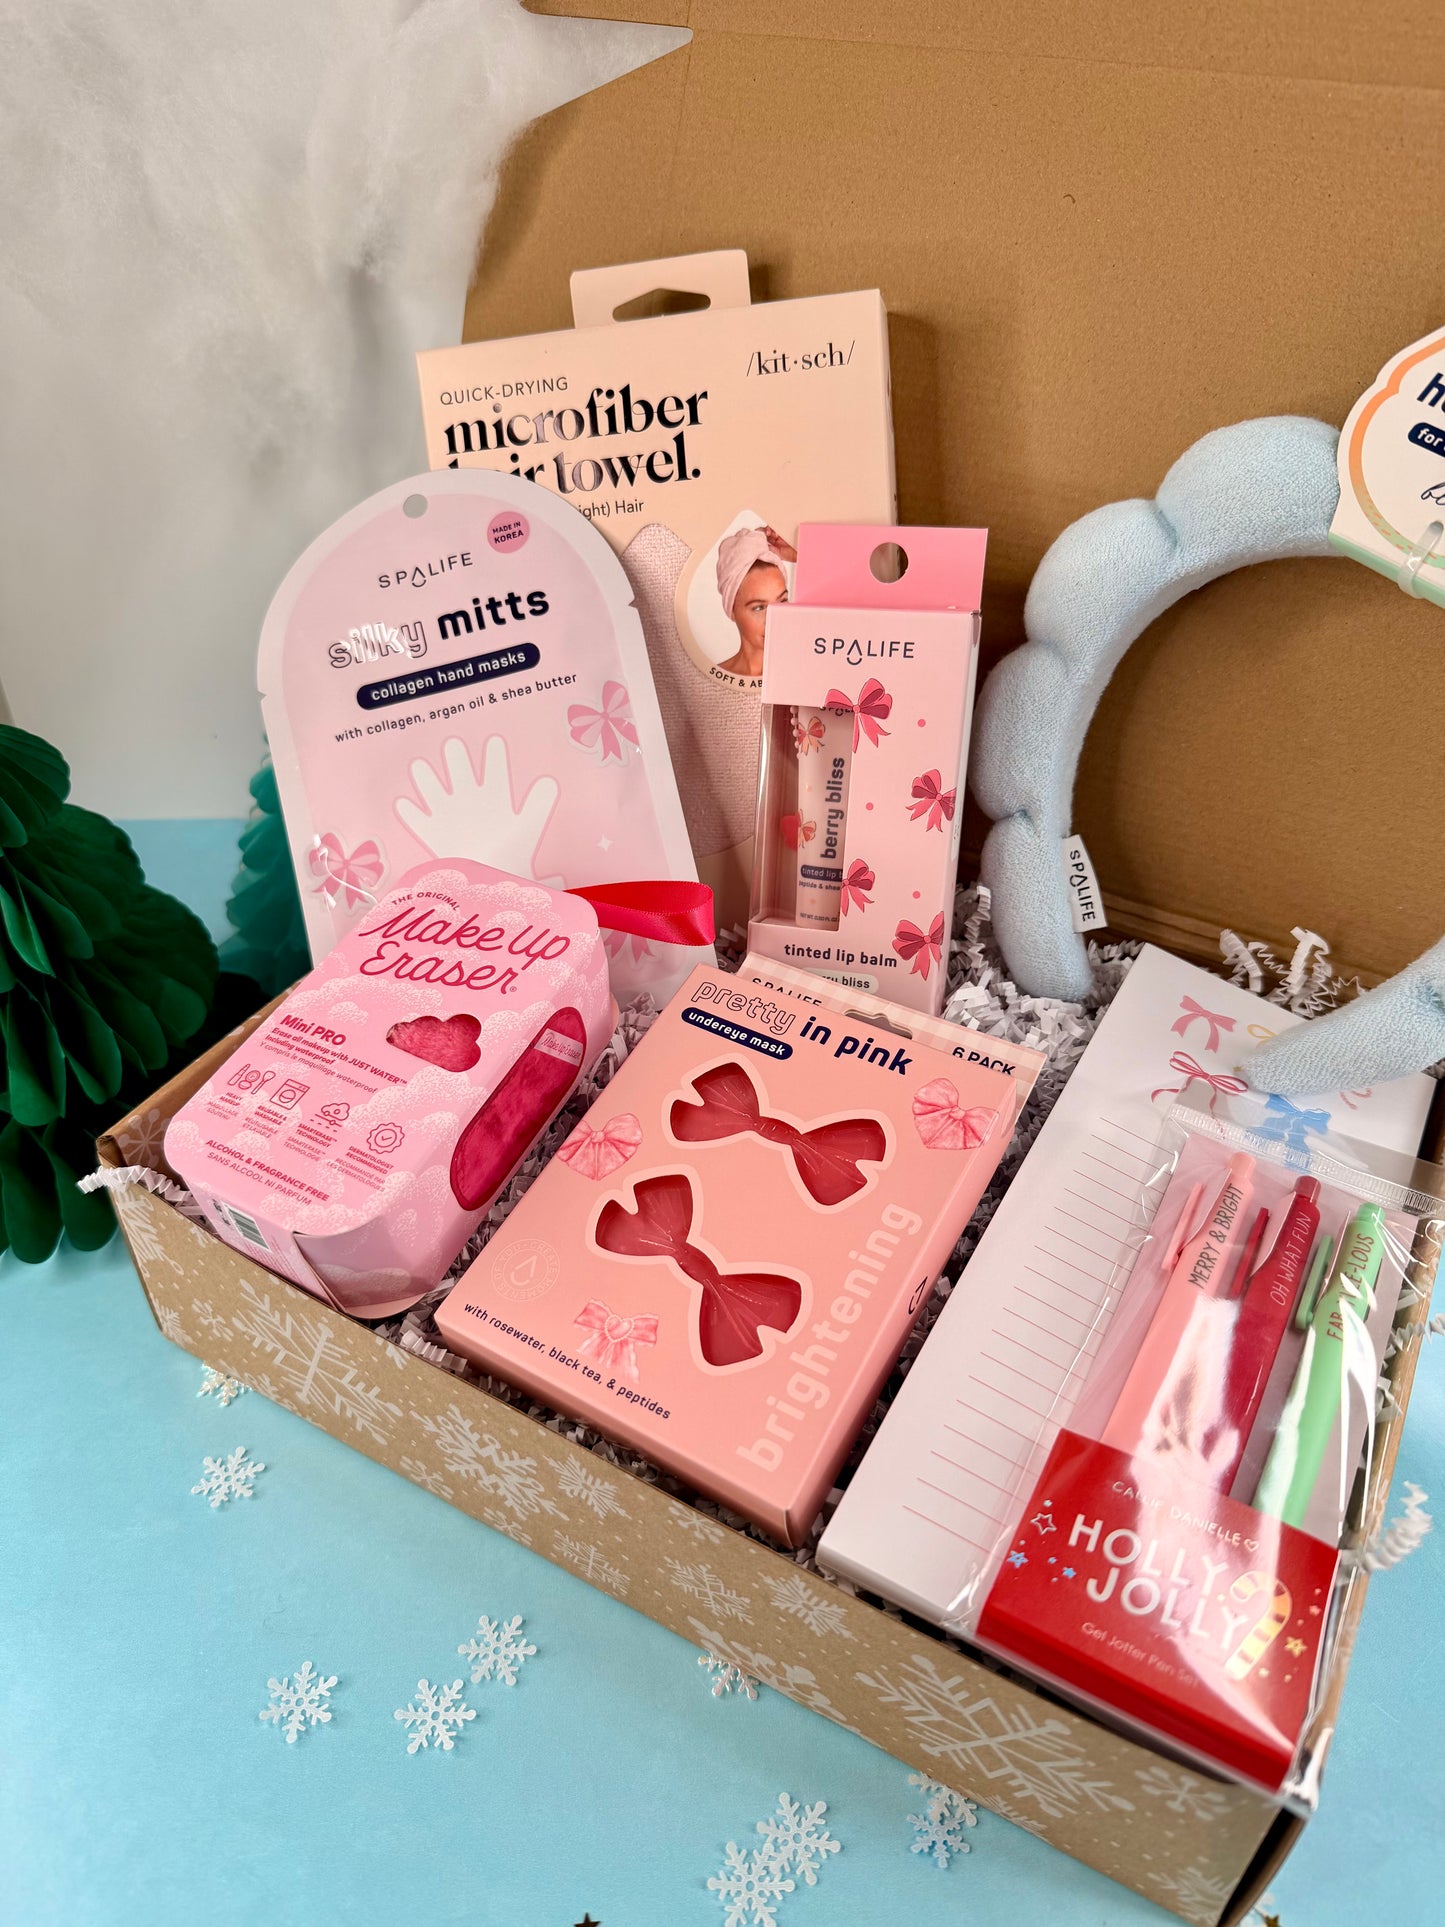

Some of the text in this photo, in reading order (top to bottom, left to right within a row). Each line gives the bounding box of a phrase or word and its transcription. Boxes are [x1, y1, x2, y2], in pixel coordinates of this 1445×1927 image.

[440, 376, 568, 405] QUICK-DRYING
[444, 383, 709, 455] microfiber
[1417, 428, 1444, 447] for
[552, 431, 701, 494] towel.
[492, 521, 522, 535] MADE IN
[615, 499, 645, 514] Hair
[494, 529, 524, 544] KOREA
[378, 552, 474, 588] SPALIFE
[328, 590, 550, 669] silky mitts
[814, 638, 915, 665] SPALIFE
[371, 651, 526, 701] collagen hand masks
[709, 667, 735, 686] SOFT
[738, 679, 746, 687] &
[335, 673, 578, 742] with collagen, argan oil & shea butter
[820, 757, 845, 859] berry bliss
[802, 867, 824, 877] tinted
[826, 870, 836, 879] lip
[1069, 850, 1096, 922] SPALIFE
[391, 891, 461, 911] THE ORIGINAL
[358, 906, 571, 970] Make Up
[784, 944, 898, 968] tinted lip balm
[841, 976, 870, 989] bliss
[265, 1034, 335, 1065] Including waterproof
[272, 1027, 292, 1040] Erase
[301, 1038, 331, 1055] makeup
[330, 1049, 349, 1062] with
[348, 1057, 371, 1072] JUST
[280, 1014, 346, 1046] Mini PRO
[688, 1011, 785, 1056] undereye mask
[690, 981, 913, 1076] pretty in pink
[264, 1044, 291, 1059] compris
[298, 1056, 336, 1076] maquillage
[336, 1070, 378, 1094] waterproof
[967, 1051, 1016, 1075] PACK
[296, 1129, 331, 1147] TECHNOLOGY
[348, 1145, 394, 1170] DERMATOLOGIST
[205, 1139, 330, 1202] ALCOHOL & FRAGRANCE FREE
[207, 1151, 313, 1206] SANS ALCOOL NI PARFUM
[345, 1152, 388, 1175] RECOMMENDED
[1187, 1183, 1244, 1290] MERRY & BRIGHT
[1270, 1211, 1312, 1306] OH WHAT FUN
[735, 1201, 924, 1473] brightening
[464, 1302, 672, 1420] with rosewater, black tea, & peptides
[1170, 1505, 1242, 1546] DANIELLE
[1067, 1514, 1229, 1596] HOLLY
[1086, 1567, 1250, 1649] JOLLY
[1082, 1622, 1108, 1641] Gel
[1108, 1635, 1147, 1661] Jotter
[1148, 1653, 1175, 1676] Pen
